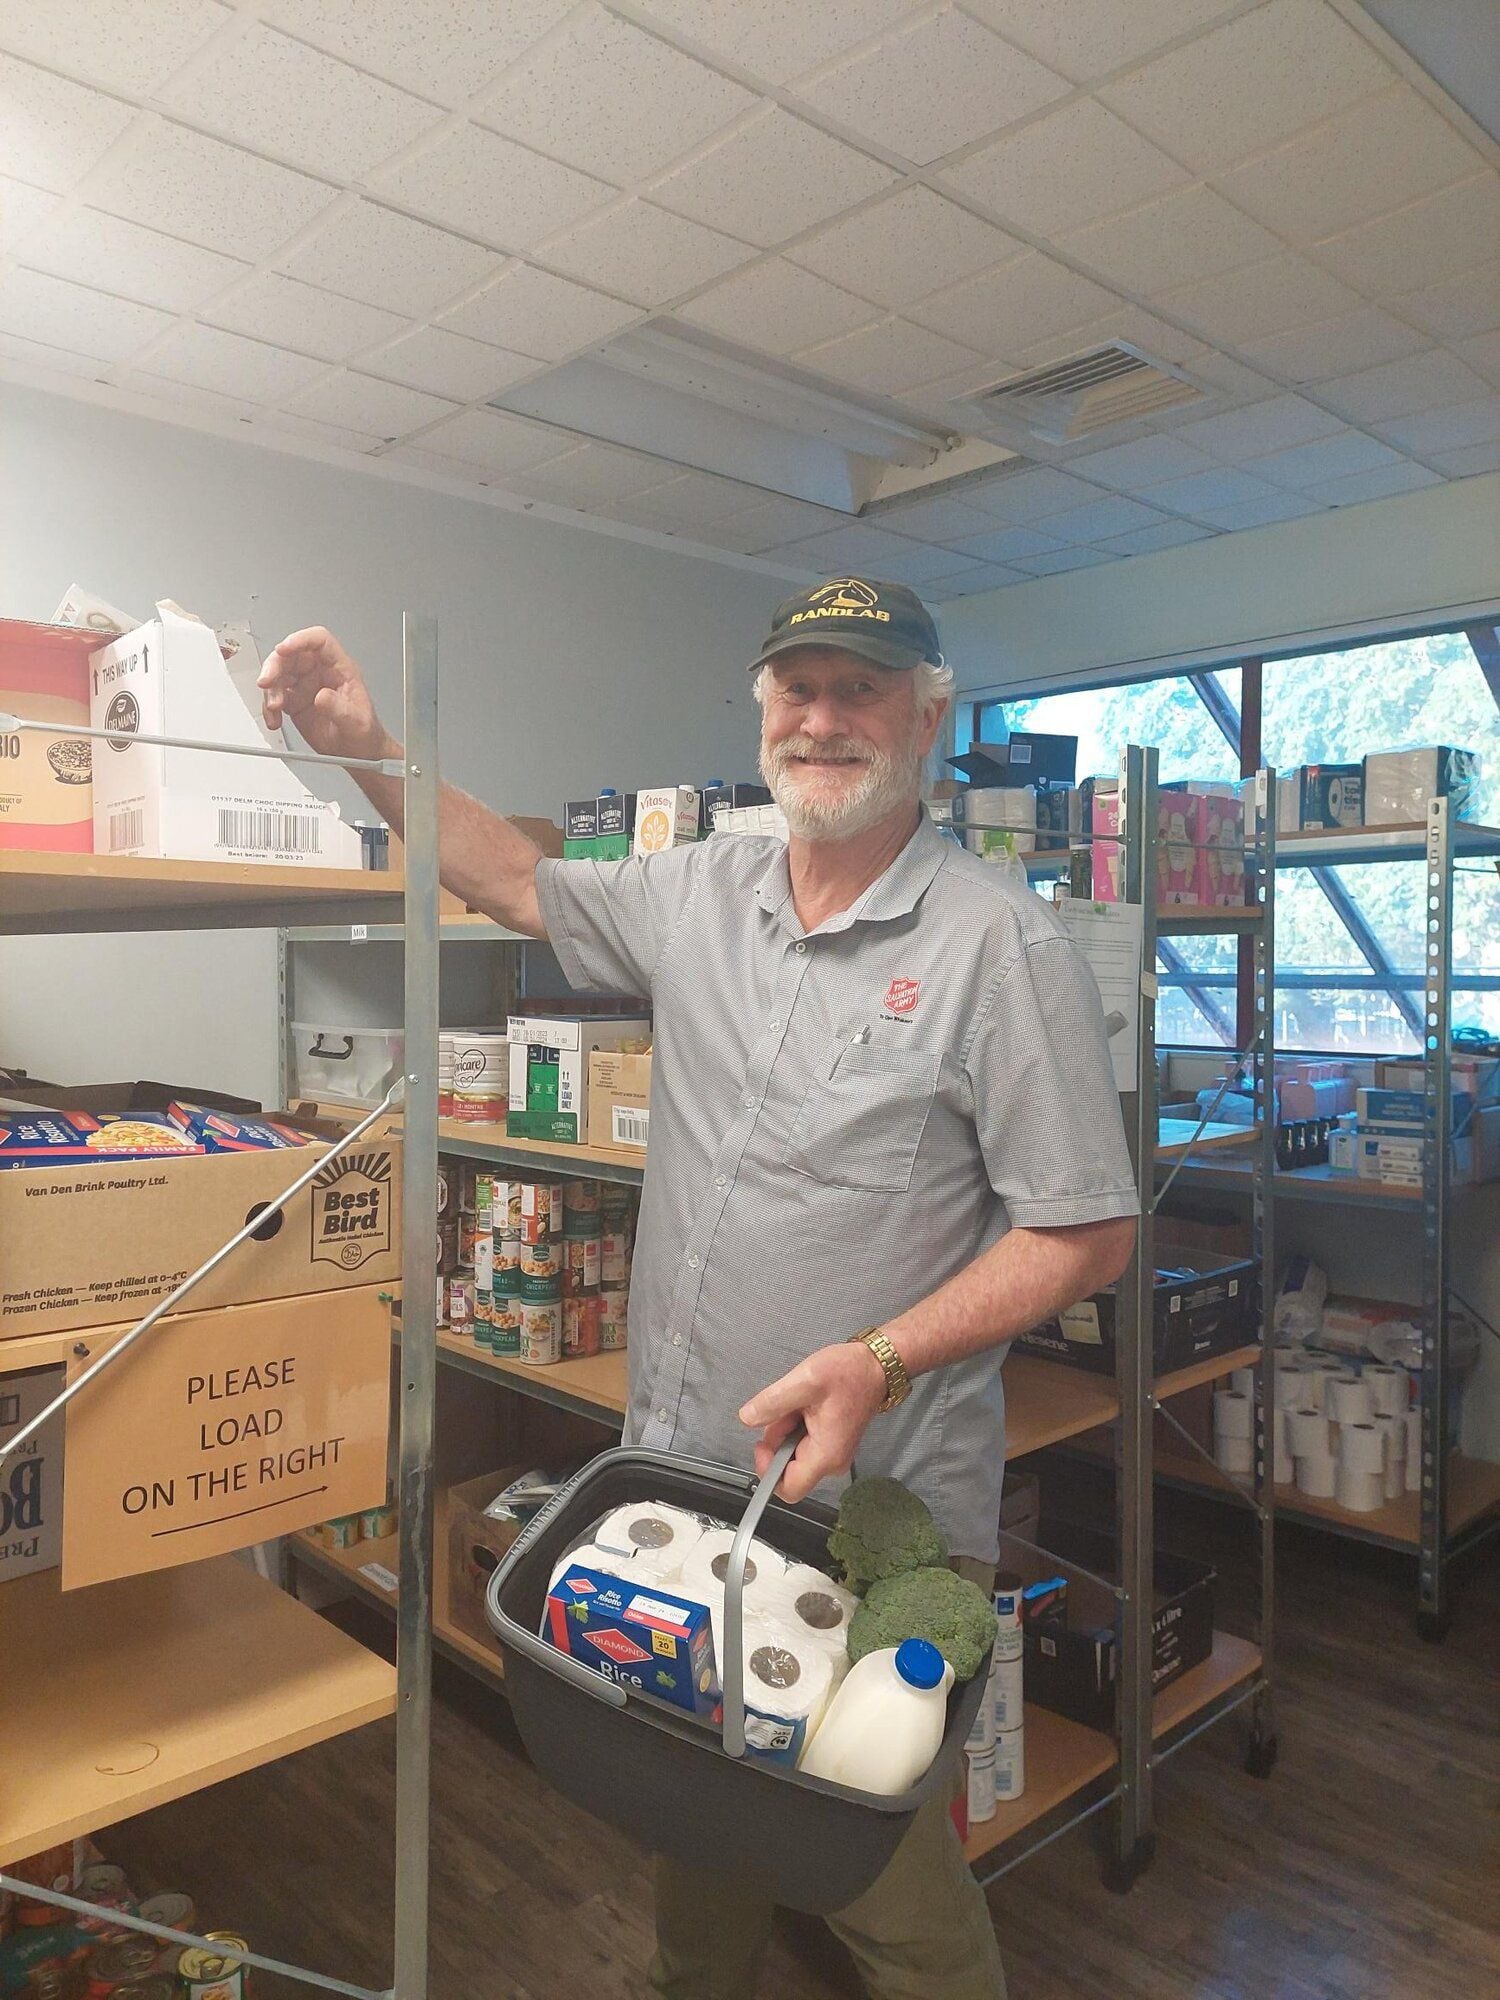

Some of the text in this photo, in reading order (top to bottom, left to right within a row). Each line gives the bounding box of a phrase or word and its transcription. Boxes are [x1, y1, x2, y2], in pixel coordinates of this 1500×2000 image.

[789, 607, 890, 625] RANDLAB
[102, 654, 138, 684] THIS WAY UP
[894, 982, 907, 992] THE
[893, 997, 913, 1009] ARMY
[18, 1125, 43, 1141] Rice
[37, 1120, 69, 1144] Risotto
[25, 1176, 169, 1197] Van Den Brink Poultry Ltd.
[324, 1187, 380, 1212] Best
[323, 1207, 379, 1235] Bird
[2, 1291, 31, 1302] Fresh
[33, 1287, 73, 1298] Chicken
[89, 1281, 112, 1292] Keep
[114, 1276, 146, 1288] chilled
[148, 1275, 158, 1284] at
[2, 1304, 37, 1315] Frozen
[39, 1298, 79, 1310] Chicken
[95, 1292, 118, 1303] Keep
[119, 1289, 150, 1301] frozen
[151, 1286, 161, 1295] at
[187, 1357, 297, 1404] PLEASE
[201, 1409, 283, 1450] LOAD
[122, 1437, 345, 1514] ON THE RIGHT
[597, 1593, 622, 1607] Risotto
[604, 1590, 621, 1600] Rice
[592, 1635, 645, 1658] DIAMOND
[658, 1640, 670, 1650] 20
[600, 1660, 643, 1689] Rice
